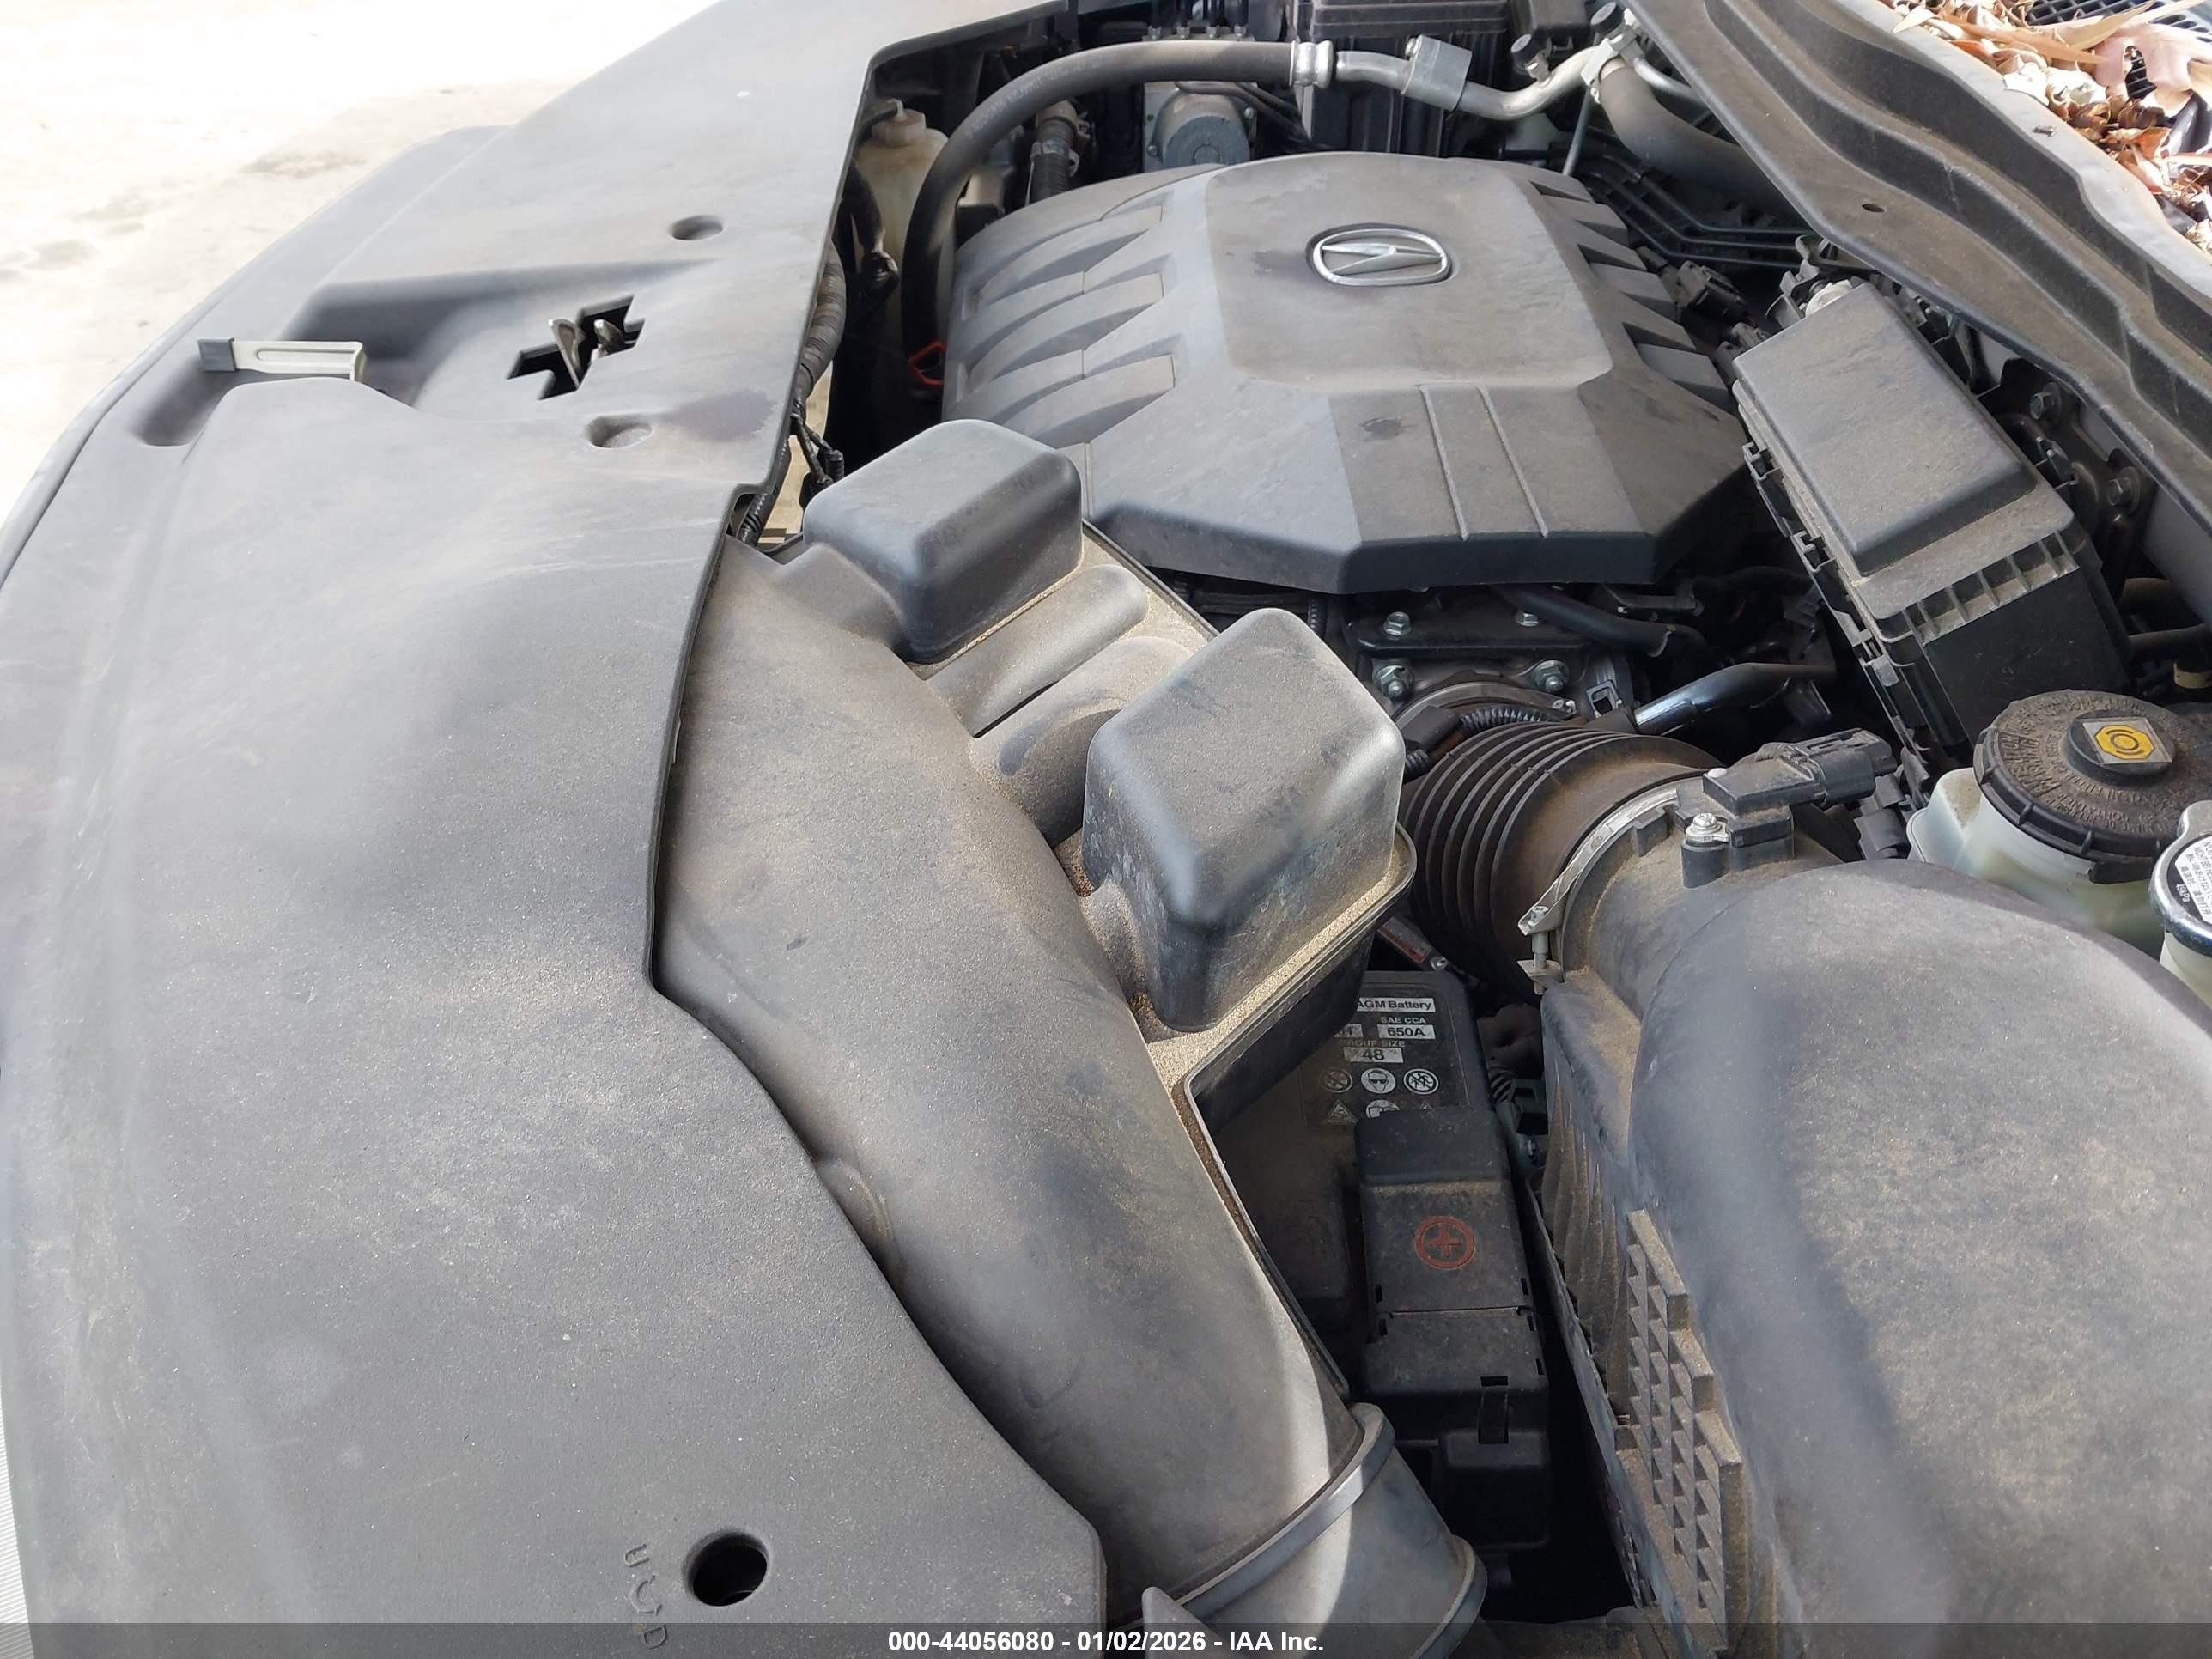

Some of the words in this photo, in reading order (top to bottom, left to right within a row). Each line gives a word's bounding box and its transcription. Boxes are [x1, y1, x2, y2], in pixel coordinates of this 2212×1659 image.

[1358, 1000, 1387, 1009] AGM
[1389, 1000, 1432, 1011] Battery
[1381, 1016, 1402, 1024] SAE
[1404, 1016, 1428, 1024] CCA
[1387, 1027, 1426, 1037] 650A
[1381, 1039, 1407, 1048] SIZE
[1363, 1048, 1385, 1060] 48
